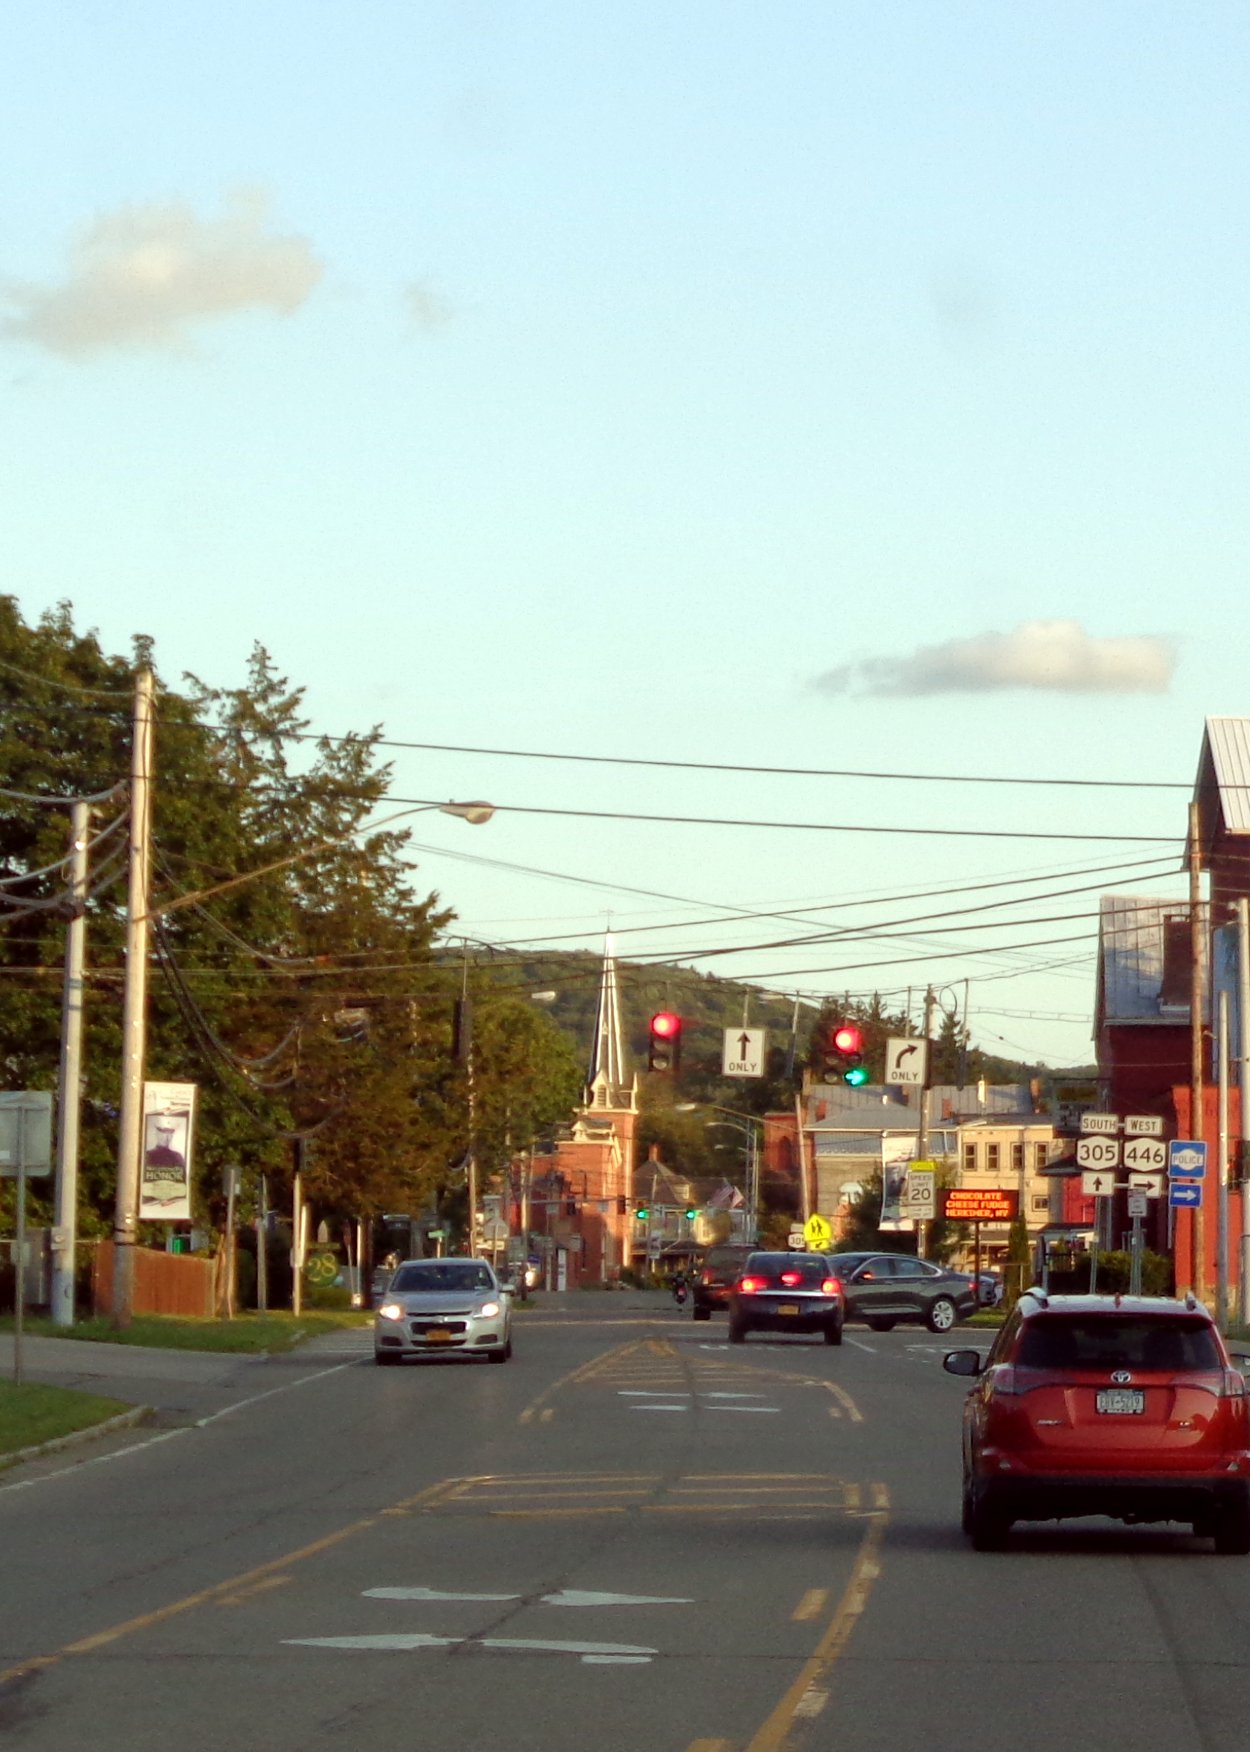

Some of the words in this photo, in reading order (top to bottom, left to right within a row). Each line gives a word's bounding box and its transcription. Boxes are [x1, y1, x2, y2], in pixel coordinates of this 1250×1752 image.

[728, 1062, 757, 1073] ONLY
[891, 1071, 919, 1081] ONLY
[1082, 1117, 1117, 1130] SOUTH
[1130, 1119, 1158, 1132] WEST
[1079, 1144, 1116, 1162] 305
[1126, 1146, 1164, 1164] 446
[1172, 1154, 1202, 1166] POLICE
[146, 1171, 184, 1181] HONOR
[911, 1187, 931, 1201] 20
[950, 1191, 1002, 1200] CHOCOLATE
[946, 1200, 979, 1209] CHEESE
[981, 1200, 1009, 1209] FUDGE
